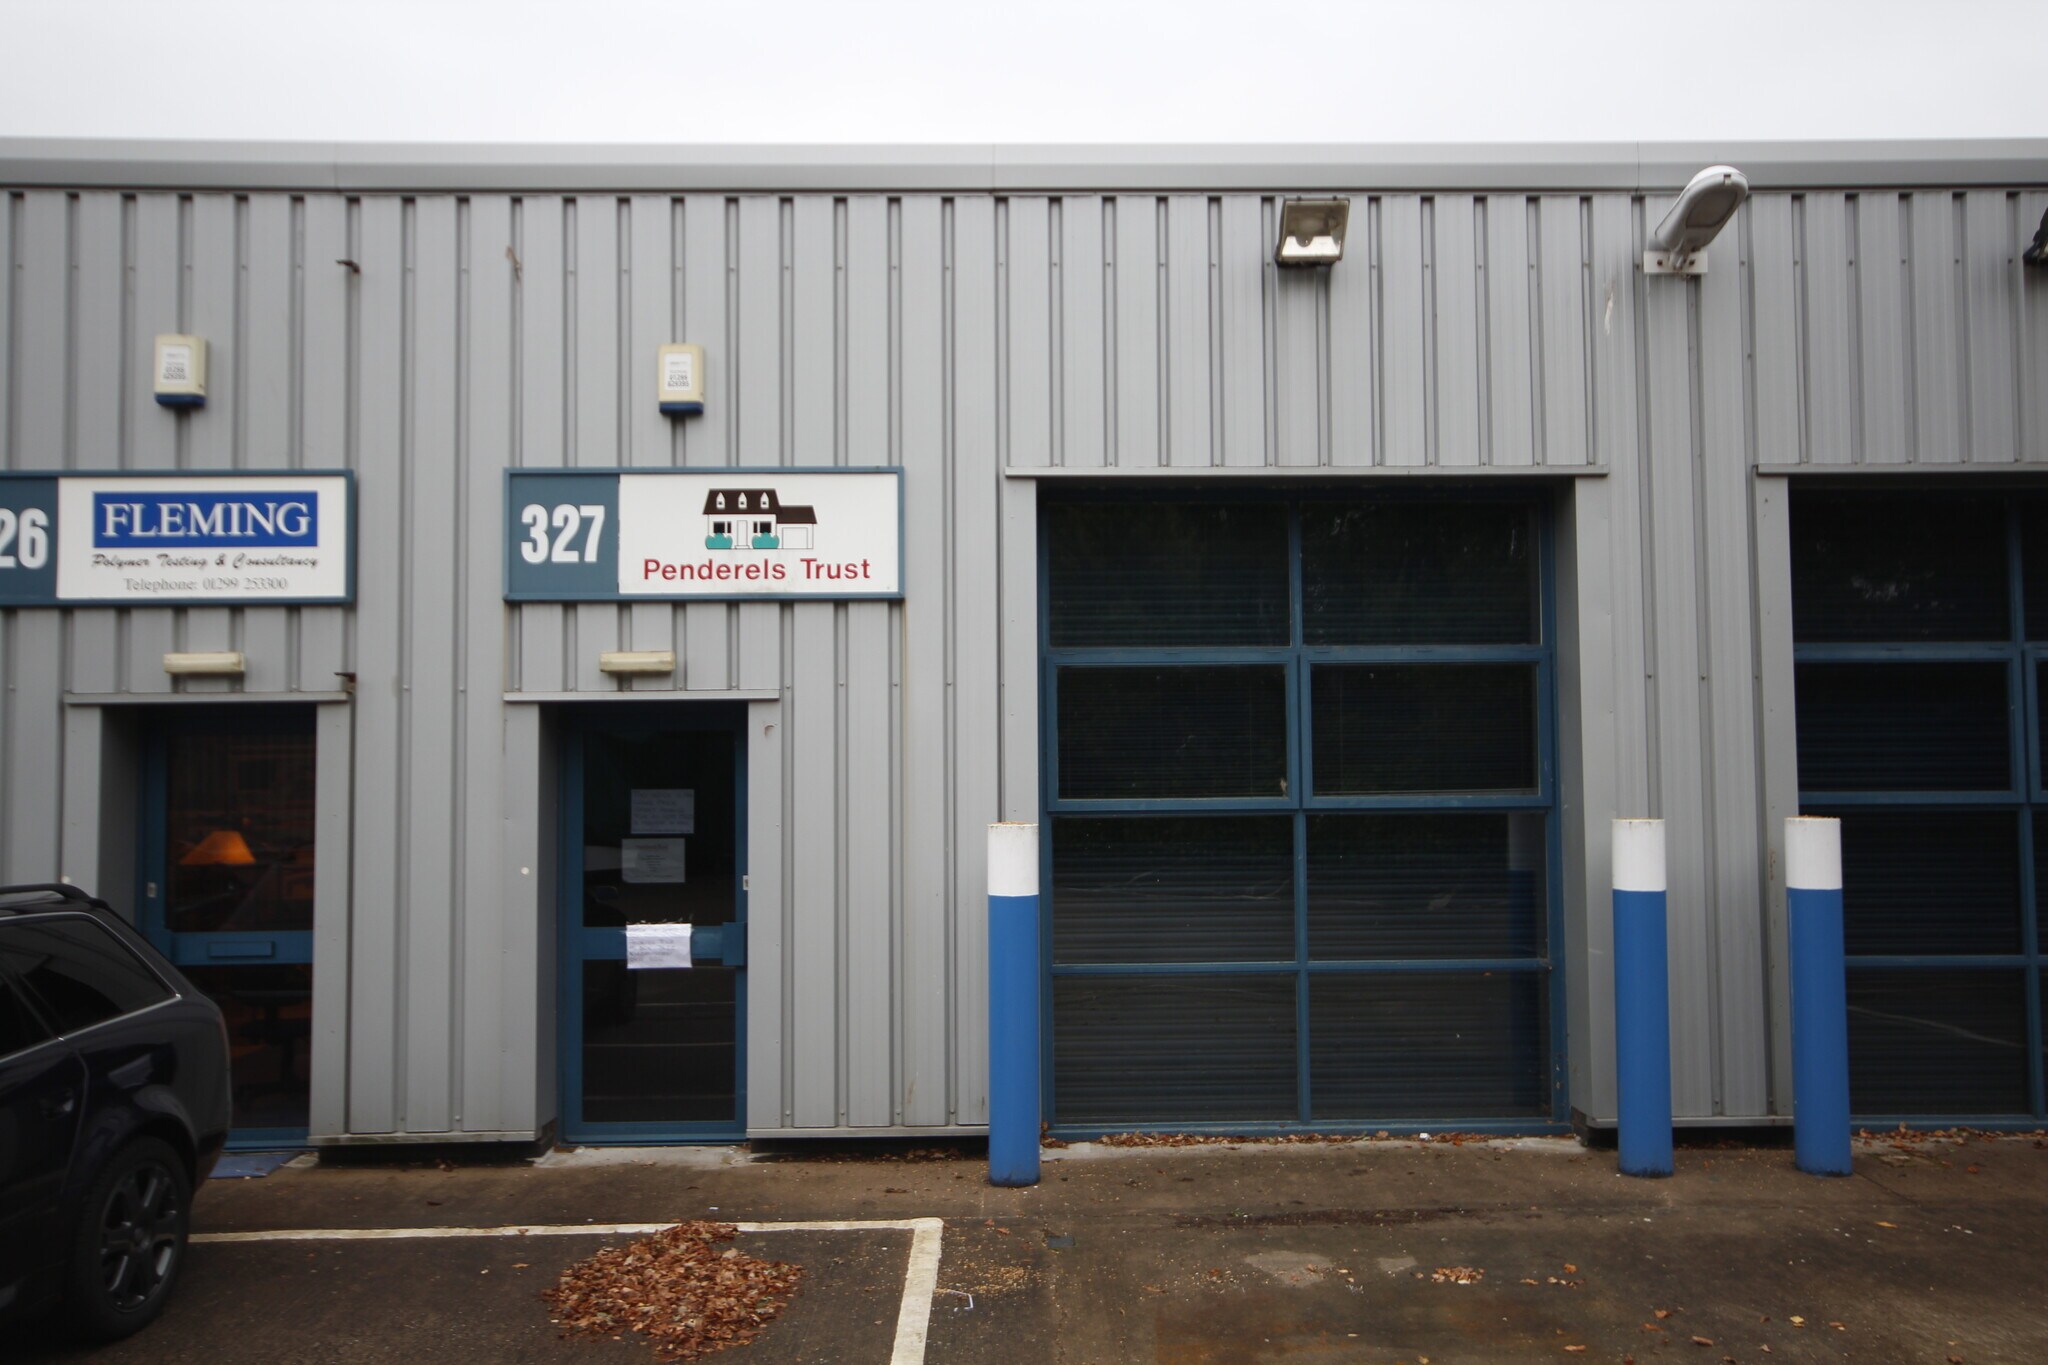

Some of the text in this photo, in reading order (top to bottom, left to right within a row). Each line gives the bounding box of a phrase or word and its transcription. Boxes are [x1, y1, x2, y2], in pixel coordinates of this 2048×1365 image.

[102, 502, 312, 537] FLEMING
[520, 503, 606, 564] 327
[0, 507, 49, 570] 26
[91, 552, 319, 570] Polymer Testing & Consultancy
[644, 557, 871, 580] Penderels Trust
[123, 577, 289, 593] Telephone: 01299 253300
